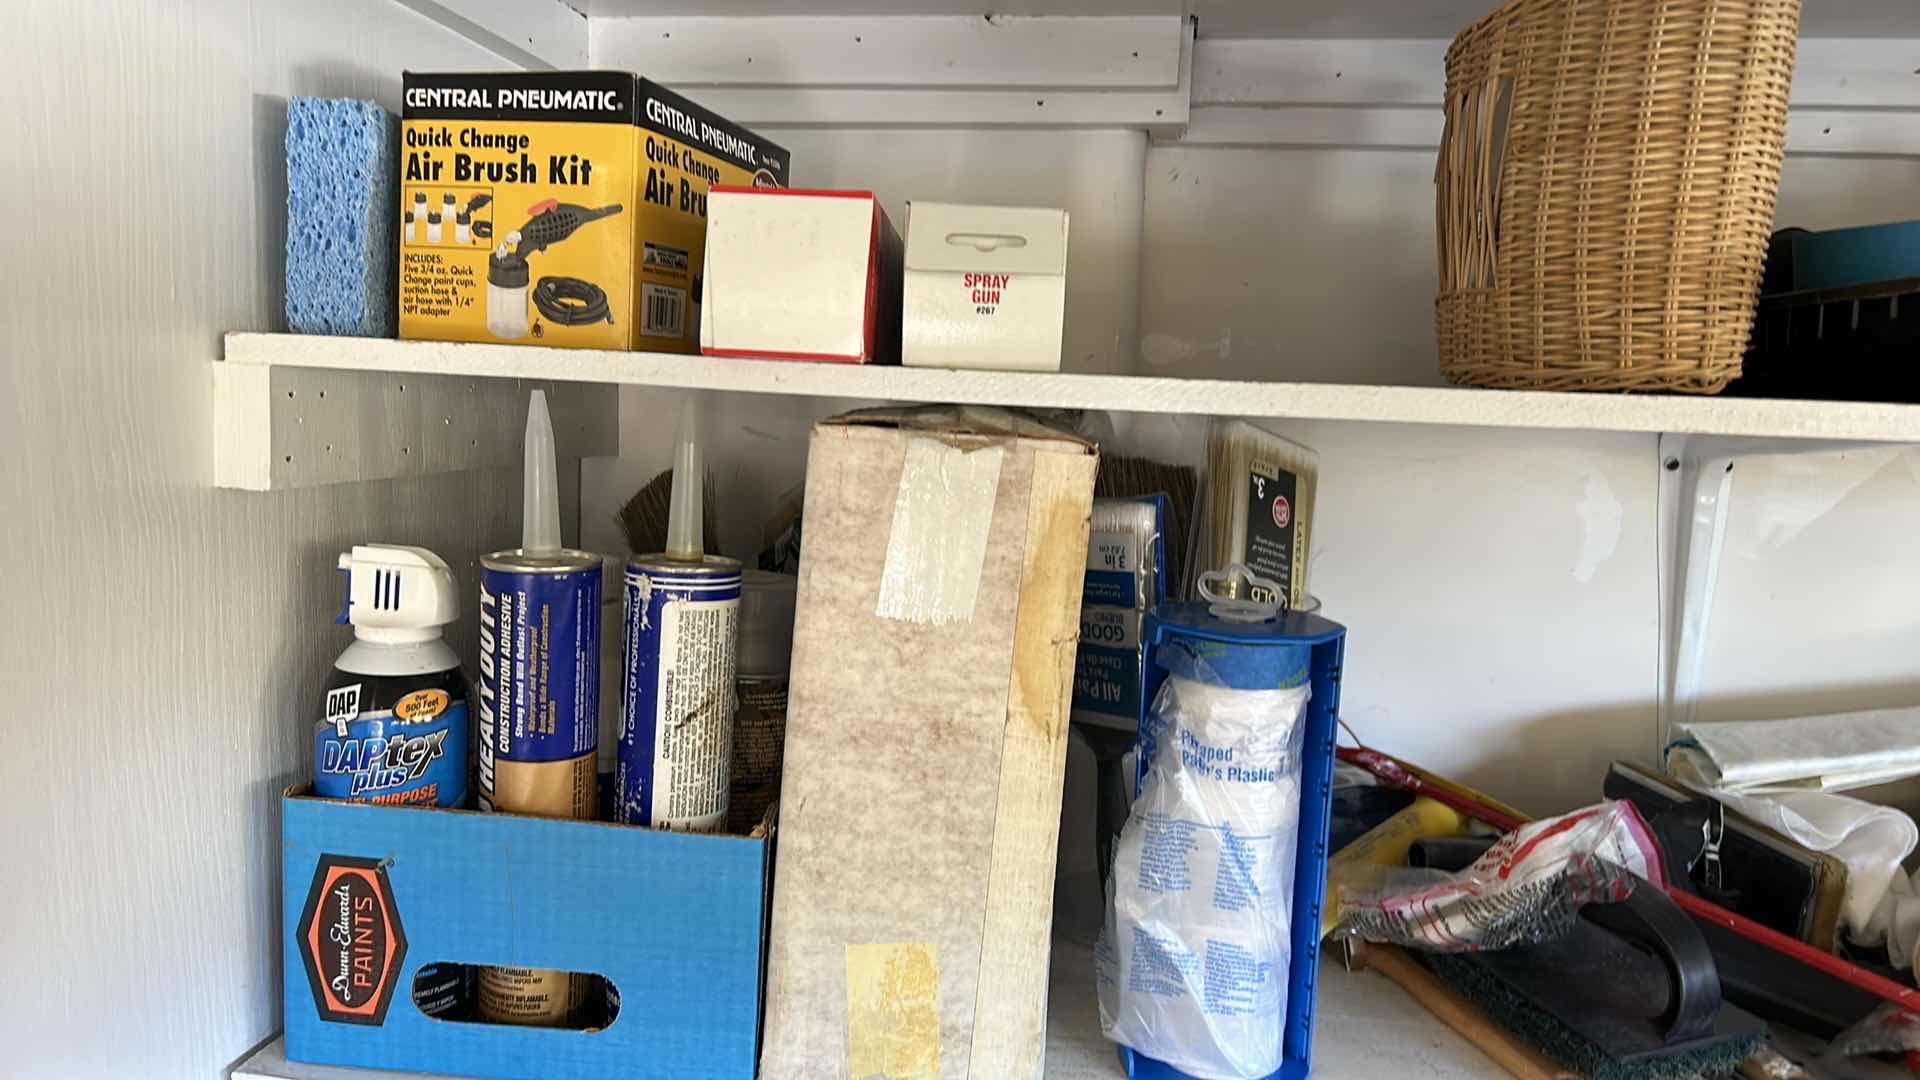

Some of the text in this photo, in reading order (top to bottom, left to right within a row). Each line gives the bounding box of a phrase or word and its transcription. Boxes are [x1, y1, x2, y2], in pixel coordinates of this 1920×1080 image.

[406, 88, 617, 111] CENTRAL PNEUMATIC
[406, 127, 530, 153] Quick Change
[646, 97, 700, 140] CENTRAL
[701, 121, 756, 166] PNEUMATIC
[406, 151, 592, 185] Air Brush Kit
[645, 136, 680, 169] Quick
[682, 149, 720, 186] Change
[644, 168, 708, 217] Air Bru
[404, 253, 443, 264] INCLUDES:
[404, 264, 418, 273] Five
[420, 264, 434, 274] 3/4
[450, 265, 473, 276] Quick
[964, 272, 1010, 289] SPRAY
[403, 275, 476, 288] Change paint cups,
[404, 285, 458, 296] suction hose &
[403, 296, 414, 304] air
[415, 296, 433, 304] hose
[435, 297, 452, 306] with
[972, 289, 1000, 305] GUN
[403, 305, 450, 318] NPT adapter
[976, 306, 995, 315] #267
[1257, 478, 1266, 499] 3
[1104, 554, 1126, 569] 3 in
[479, 580, 496, 681] DUTY
[499, 592, 513, 754] CONSTRUCTION ADHESIVE
[515, 591, 528, 739] Strong Bond Will Outlast Project
[629, 674, 637, 689] OF
[1103, 680, 1121, 702] All
[328, 690, 357, 718] DAP
[405, 697, 439, 713] 500 Feet
[628, 689, 637, 731] CHOICE
[479, 673, 495, 793] HEAVY
[628, 732, 635, 746] #1
[322, 729, 448, 780] DAPtex
[351, 763, 408, 796] plus
[1227, 767, 1275, 783] Plastic
[371, 784, 438, 806] PURPOSE
[330, 884, 352, 1001] Dunn-Edwards
[354, 896, 374, 987] PAINTS
